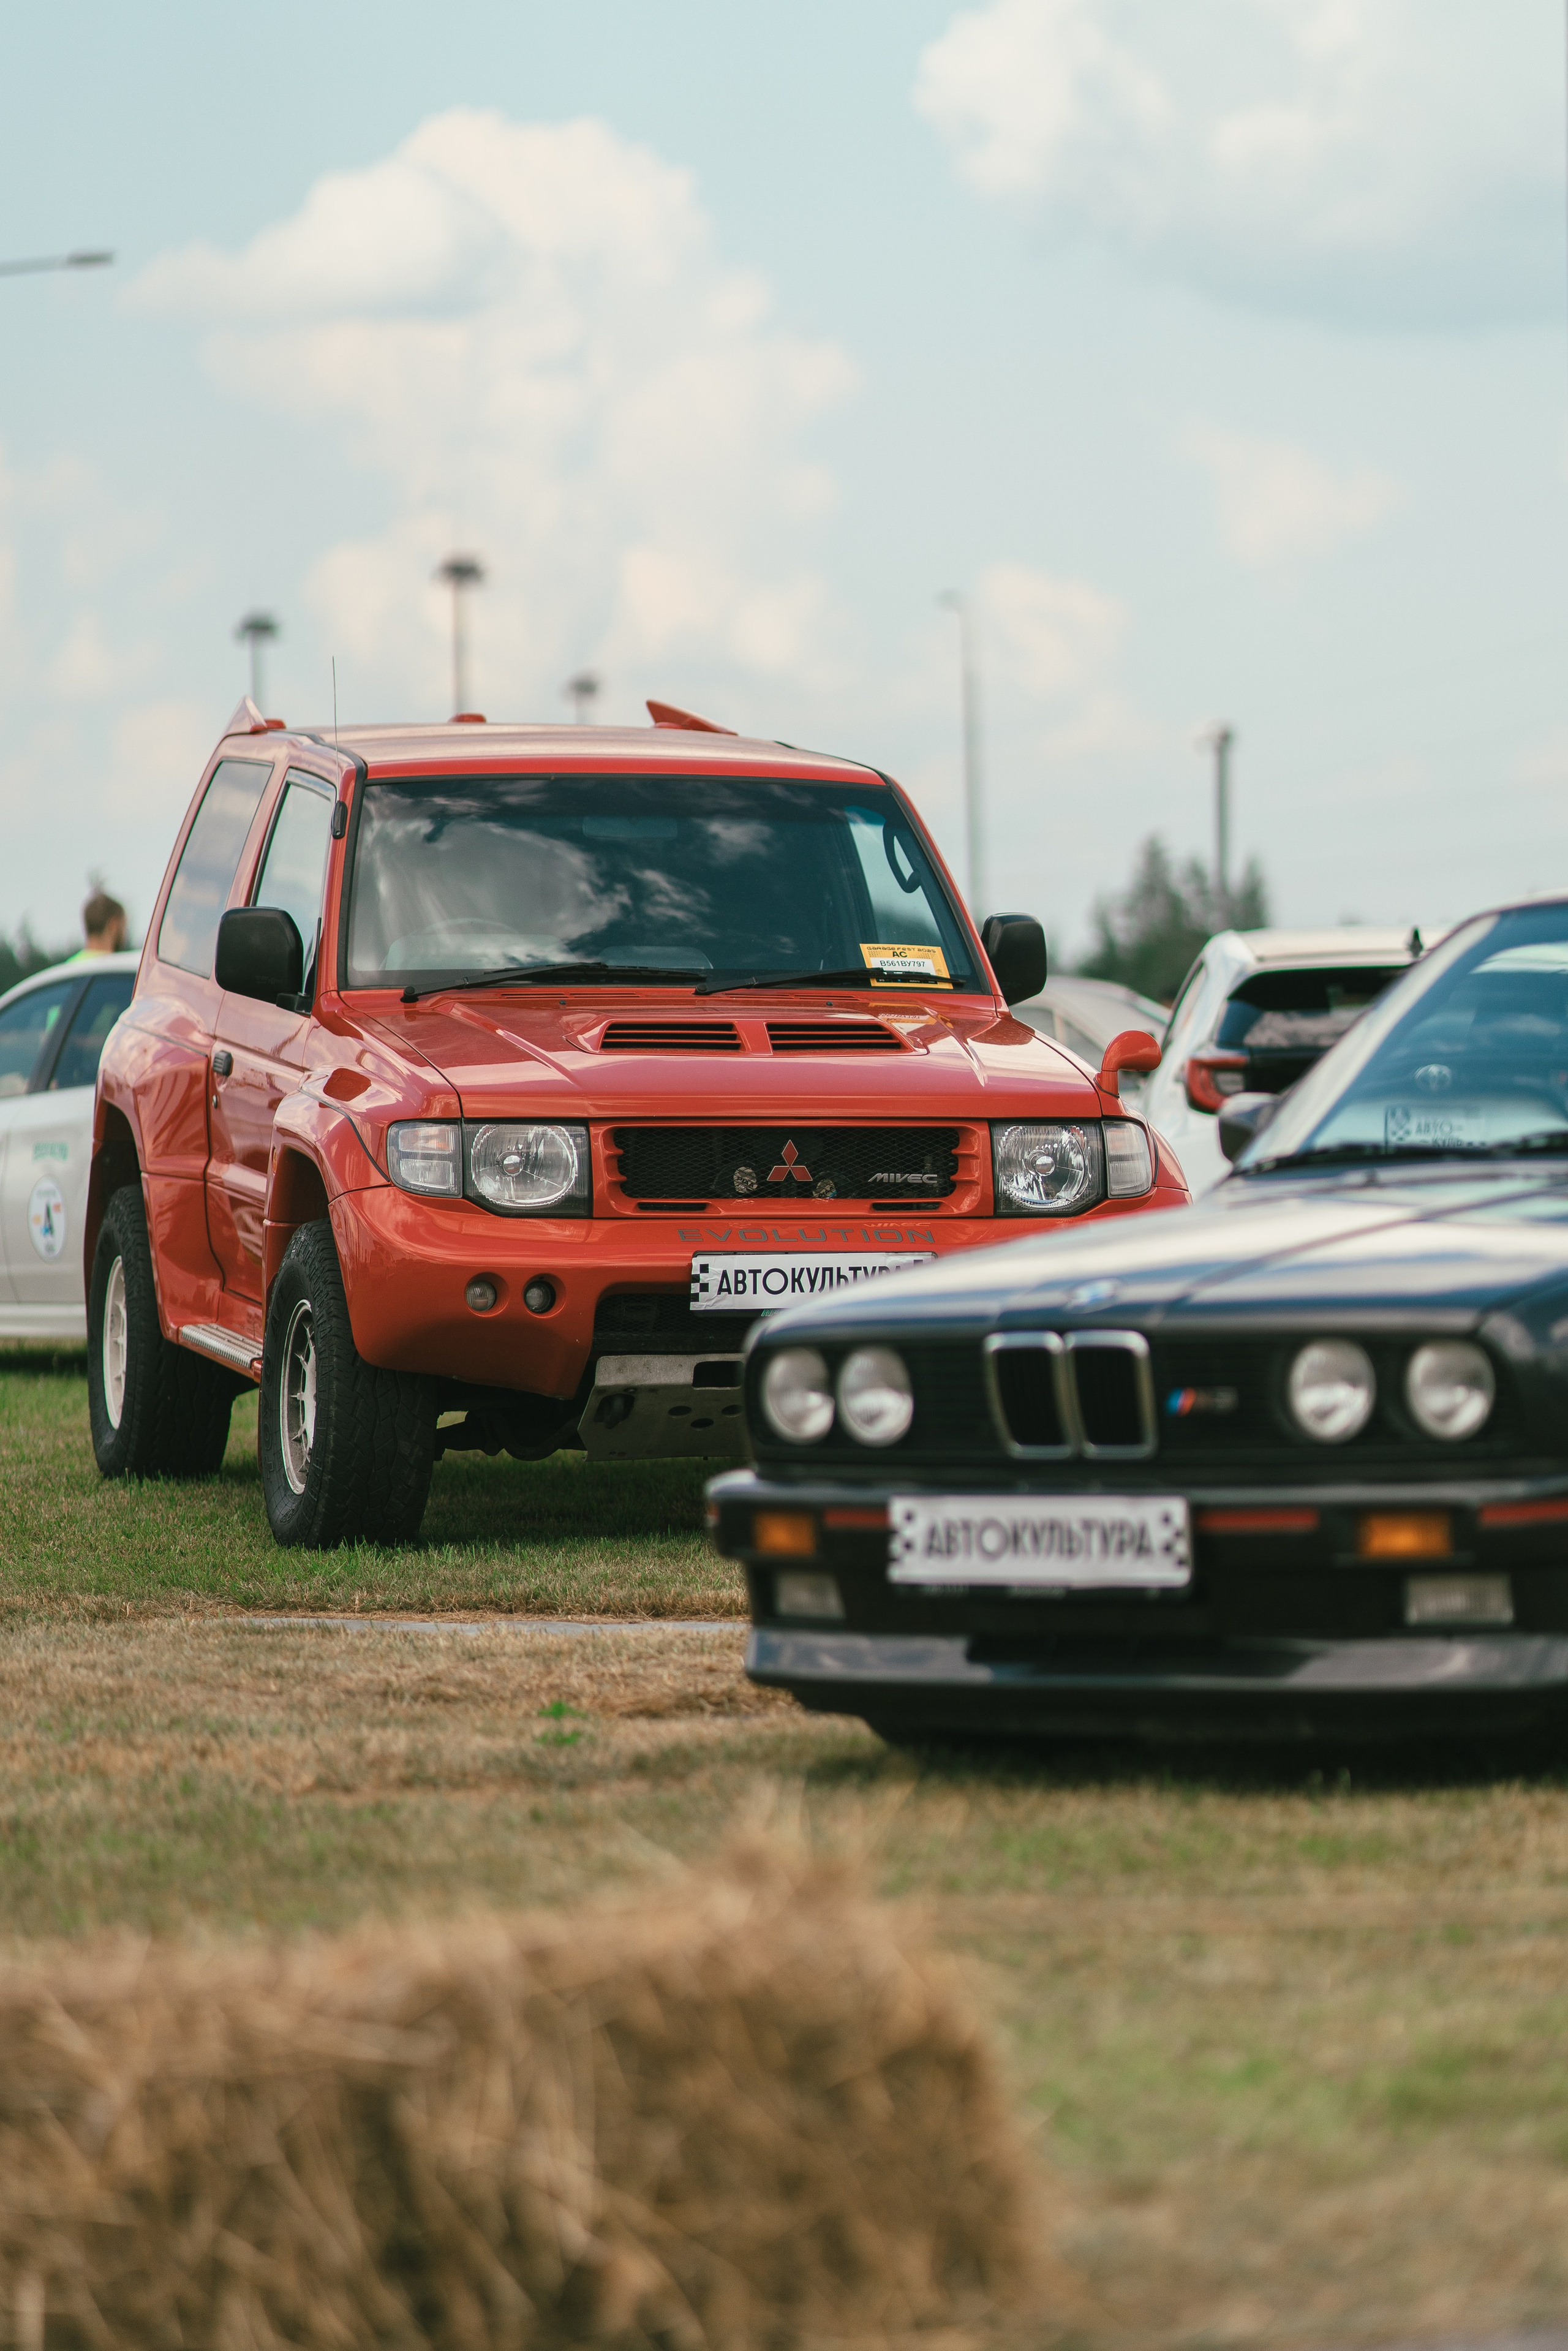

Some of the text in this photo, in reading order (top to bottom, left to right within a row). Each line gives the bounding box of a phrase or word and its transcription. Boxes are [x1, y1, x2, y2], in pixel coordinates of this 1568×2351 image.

[868, 1173, 938, 1183] MIVEC
[677, 1228, 935, 1243] EVOLUTION
[717, 1266, 901, 1295] АВТОКУЛЬТУ
[926, 1517, 1154, 1562] АВТОКУЛЬТУРА
